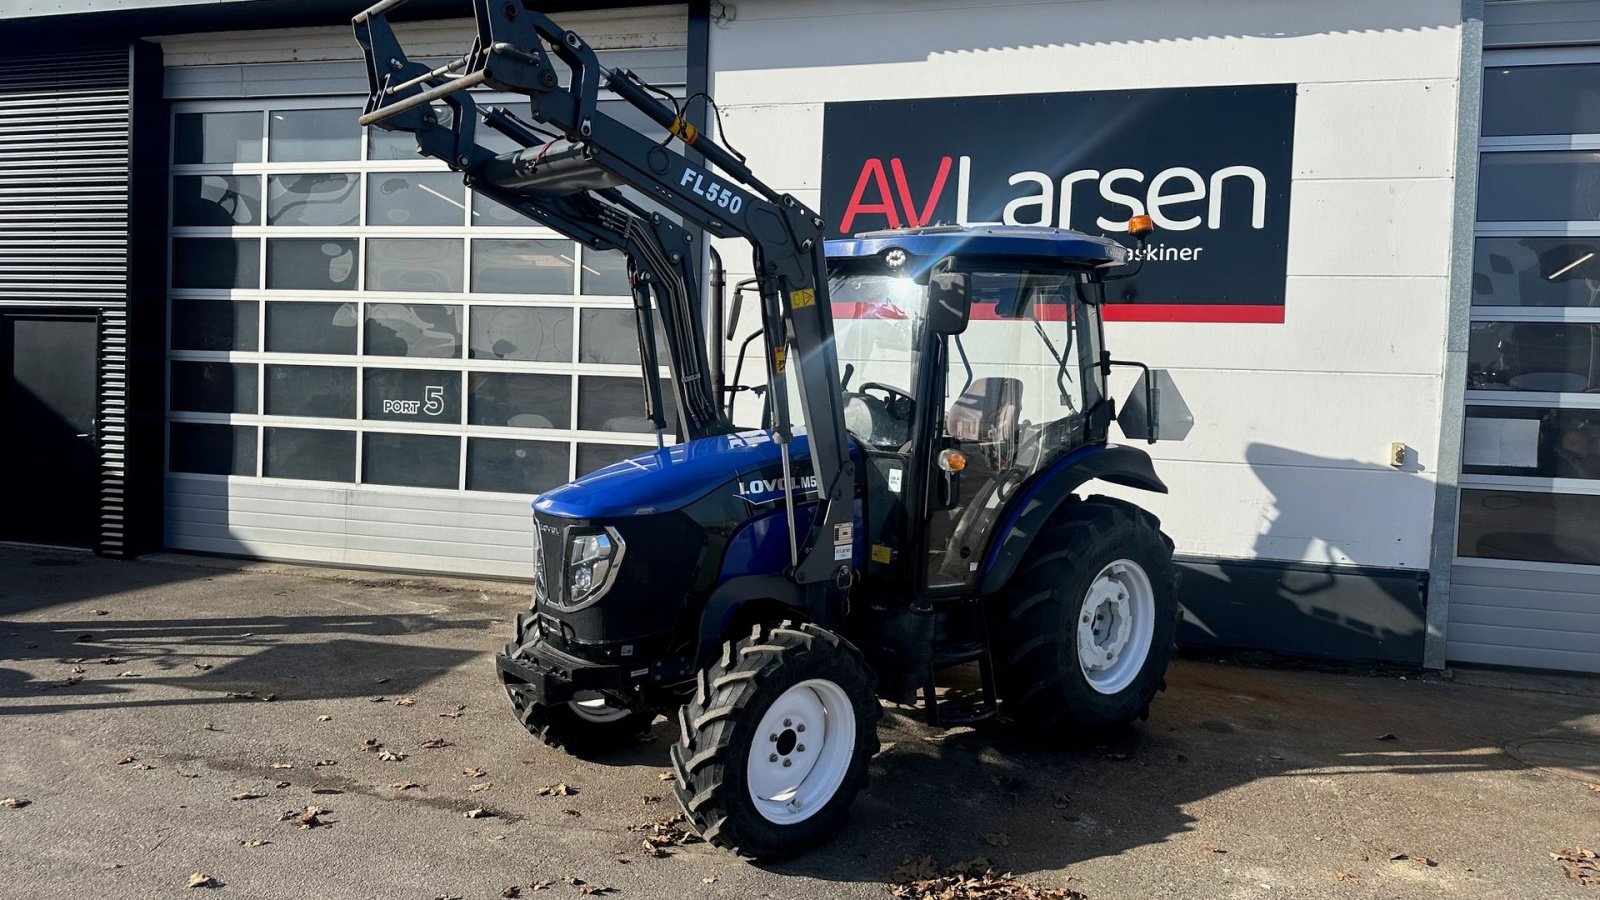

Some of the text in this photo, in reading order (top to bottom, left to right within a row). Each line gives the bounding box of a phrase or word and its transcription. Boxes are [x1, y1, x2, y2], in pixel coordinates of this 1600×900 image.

[680, 167, 742, 214] FL550
[1126, 243, 1203, 261] askiner
[383, 385, 444, 415] PORT 5
